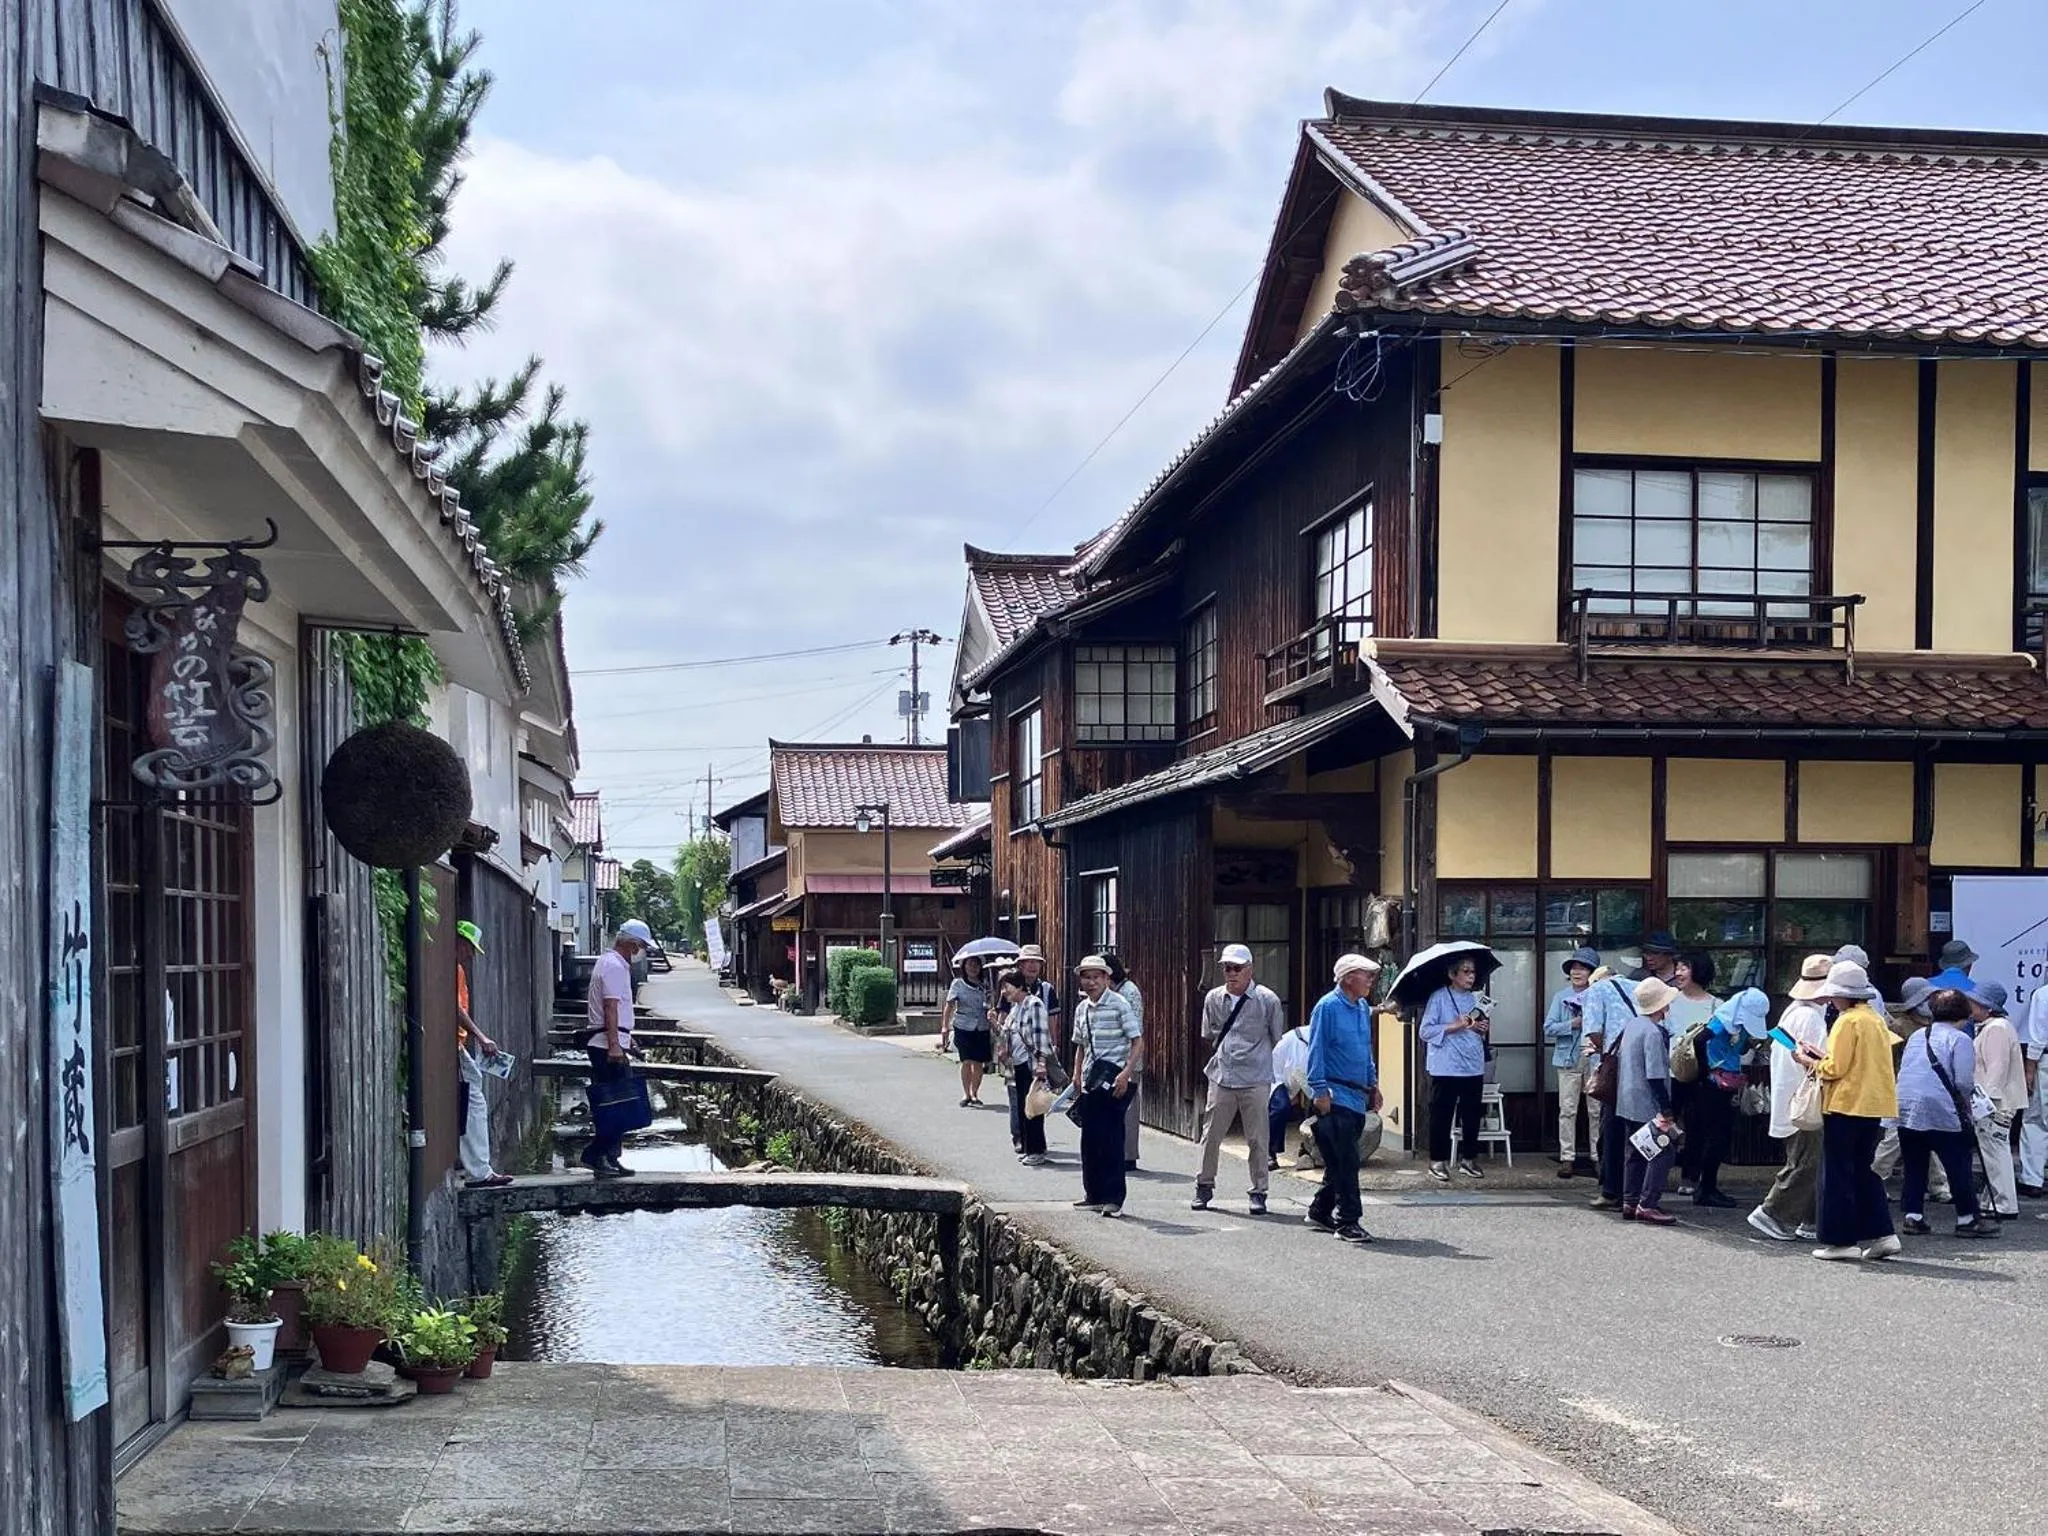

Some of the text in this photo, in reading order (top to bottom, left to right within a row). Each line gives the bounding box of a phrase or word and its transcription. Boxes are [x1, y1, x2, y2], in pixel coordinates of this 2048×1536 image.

[163, 605, 226, 747] なかの竹芸
[2017, 960, 2048, 978] to
